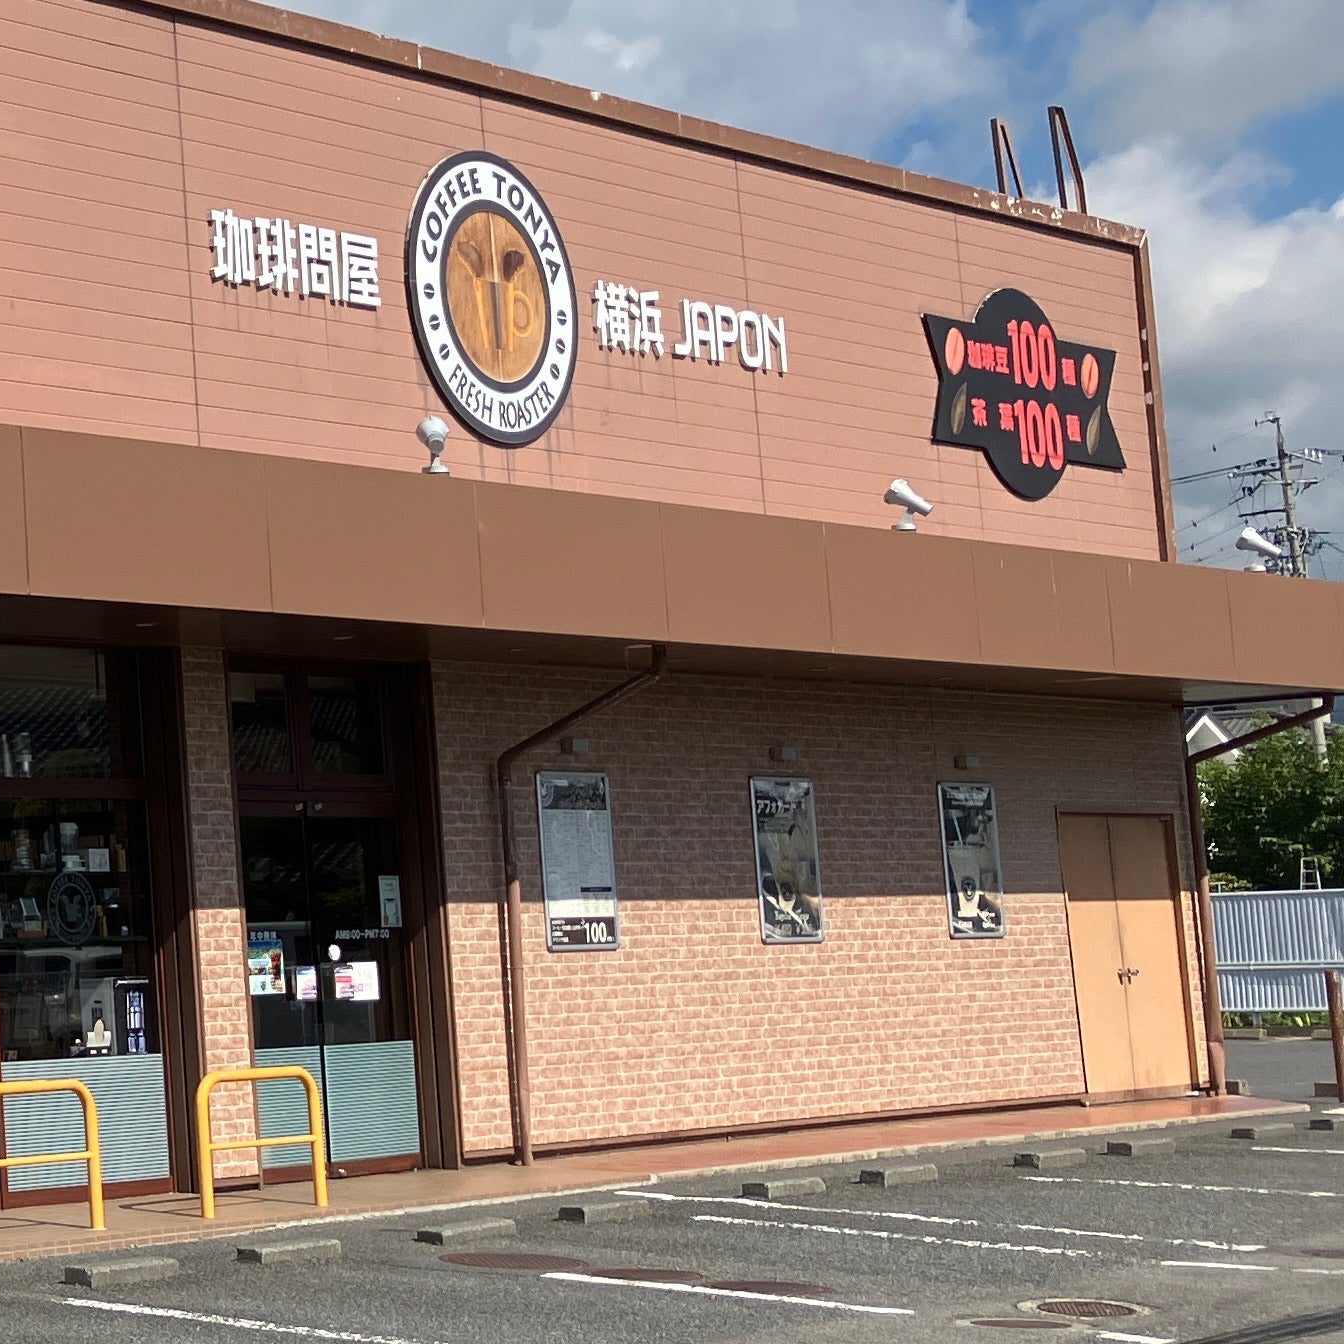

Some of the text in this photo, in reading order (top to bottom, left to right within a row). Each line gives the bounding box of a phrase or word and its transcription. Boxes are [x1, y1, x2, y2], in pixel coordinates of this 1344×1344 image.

[209, 208, 382, 308] 珈琲問屋
[421, 166, 563, 286] COFFEE TONYA
[594, 279, 788, 373] 横浜 JAPON
[448, 367, 556, 430] FRESH ROASTER
